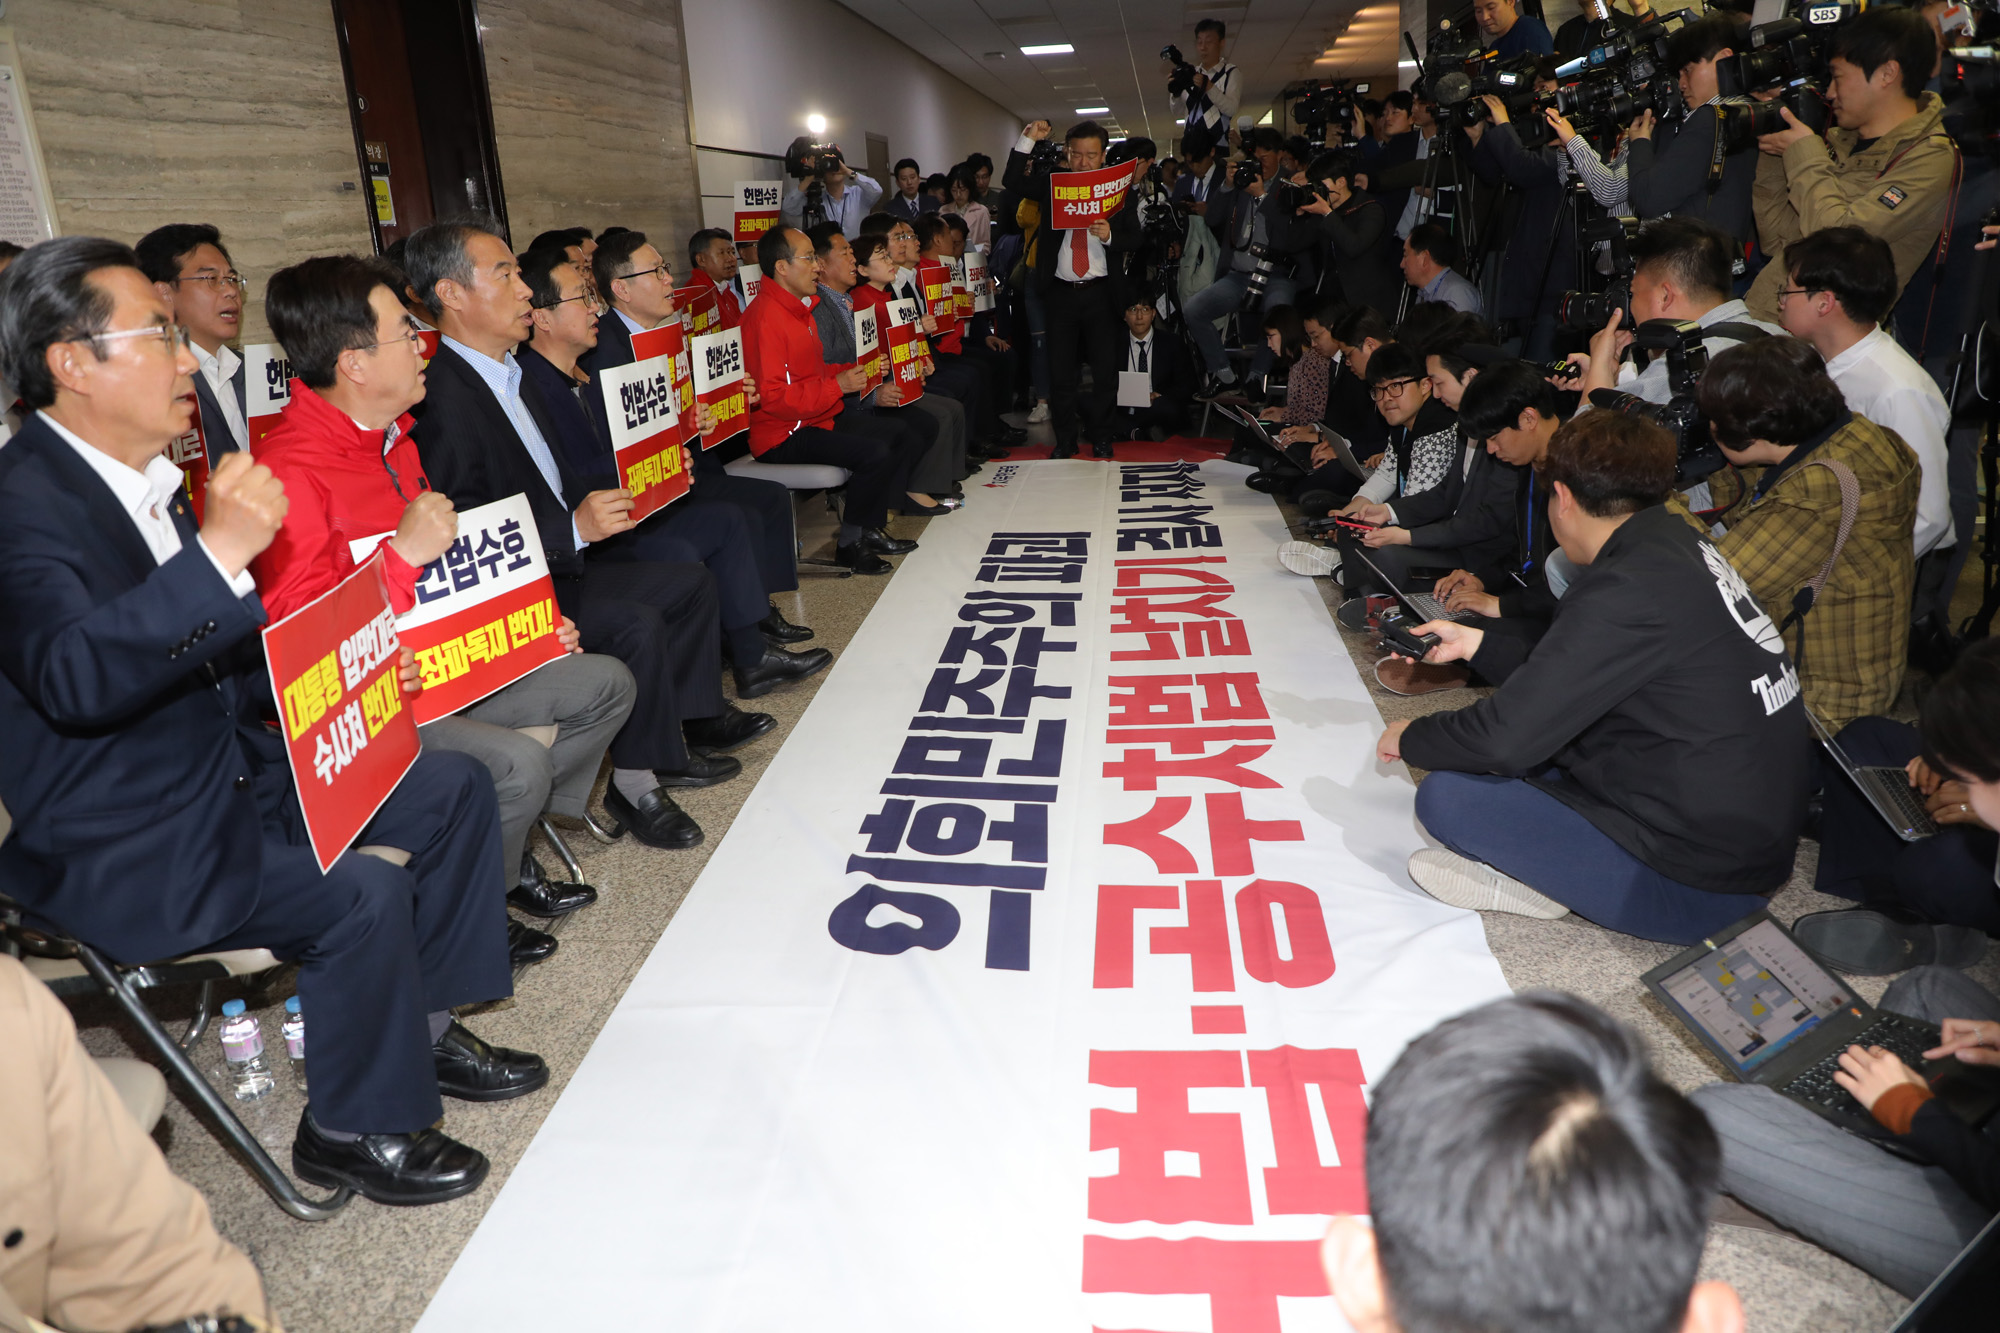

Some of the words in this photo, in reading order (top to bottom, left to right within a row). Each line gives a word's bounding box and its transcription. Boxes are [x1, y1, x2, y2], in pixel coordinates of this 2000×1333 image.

[1813, 9, 1837, 21] SBS
[1500, 73, 1516, 83] KBS
[744, 187, 778, 206] 헌법수호
[1054, 186, 1091, 200] 대통령
[1093, 172, 1133, 198] 입맛대로
[1063, 200, 1101, 215] 수사처
[1102, 190, 1125, 213] 반대!
[739, 218, 770, 233] 좌파독재
[925, 284, 942, 301] 대통령
[692, 311, 708, 332] 대통령
[705, 340, 741, 380] 헌법수호
[891, 342, 911, 364] 대통령
[900, 362, 917, 383] 수사처
[620, 372, 670, 430] 헌법수호
[729, 392, 745, 419] 반대!
[626, 452, 664, 498] 좌파독재
[660, 443, 683, 481] 반대!
[1119, 462, 1206, 500] 저지!
[1116, 504, 1223, 552] 결사
[1110, 555, 1252, 661] 날치기
[414, 618, 510, 691] 좌파독재
[506, 598, 554, 650] 반대!
[283, 650, 343, 742] 대통령
[313, 699, 369, 786] 수사처
[360, 665, 402, 739] 반대!
[828, 590, 1083, 972] 의회민주주의
[974, 531, 1092, 583] 파괴
